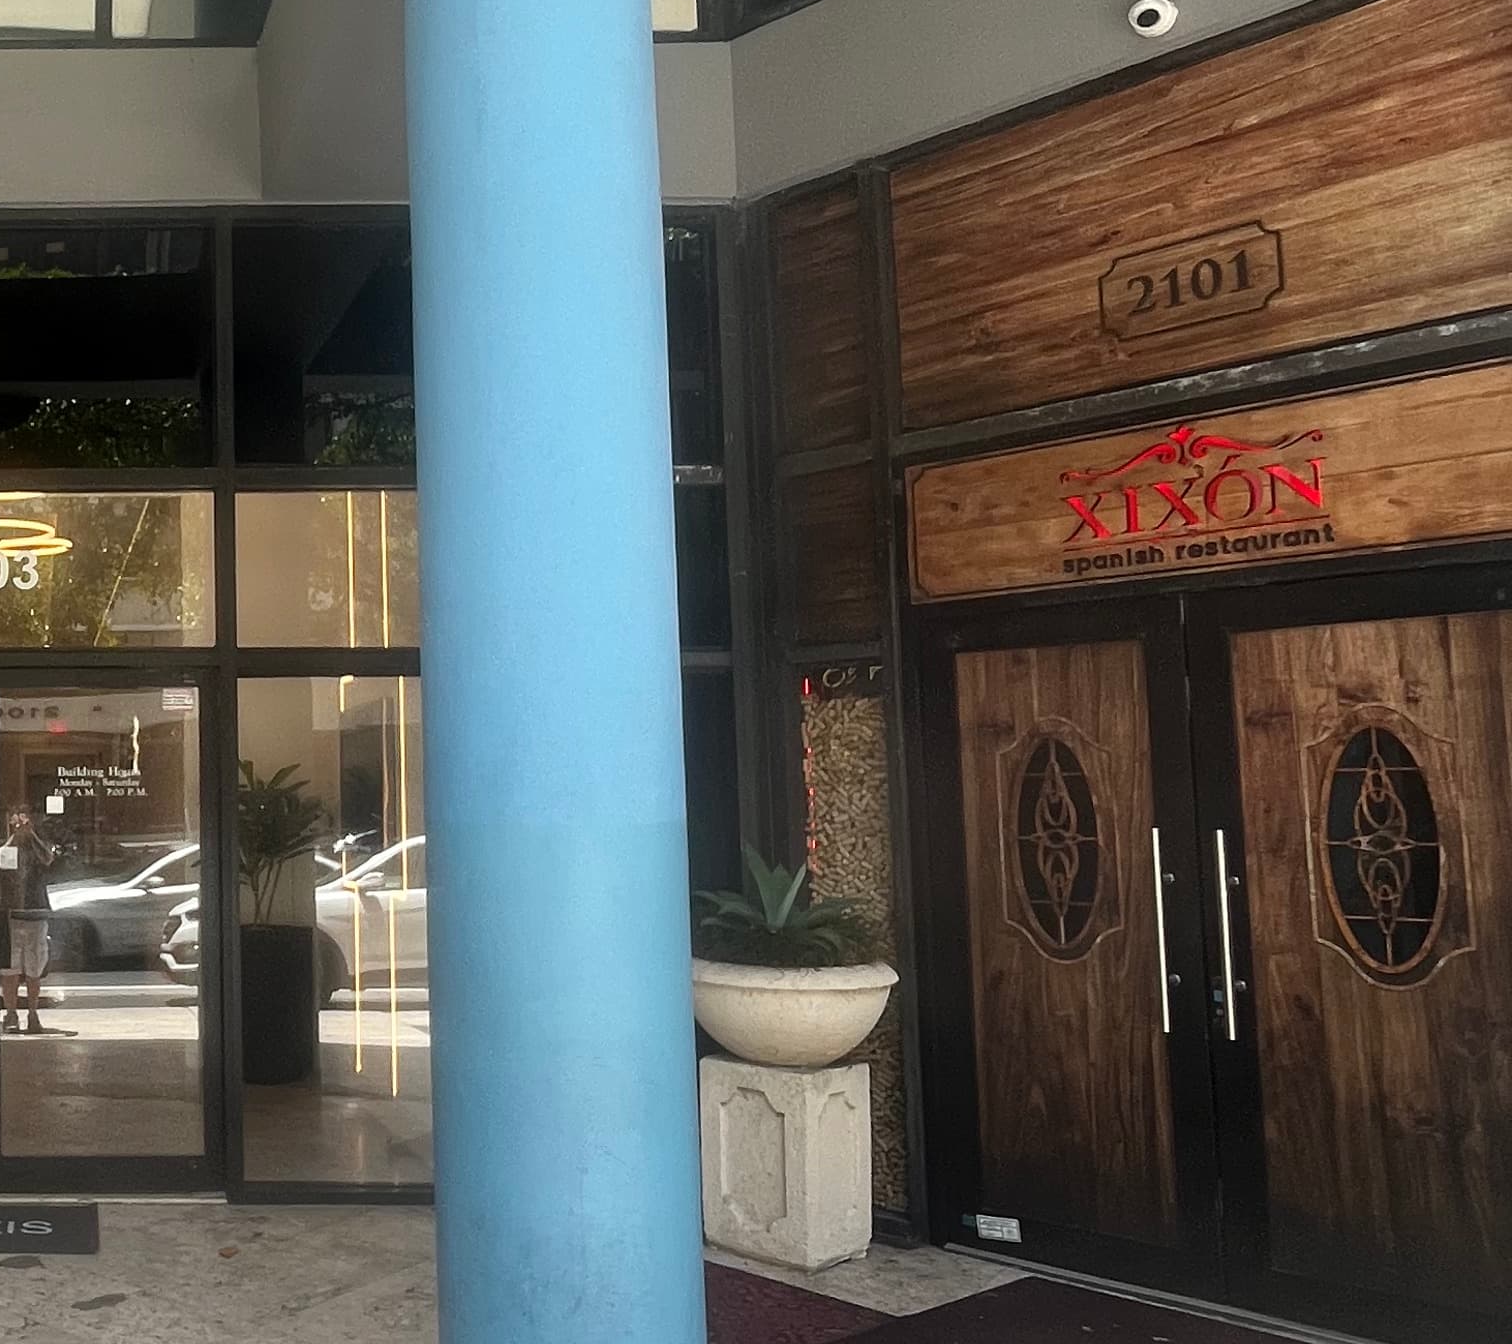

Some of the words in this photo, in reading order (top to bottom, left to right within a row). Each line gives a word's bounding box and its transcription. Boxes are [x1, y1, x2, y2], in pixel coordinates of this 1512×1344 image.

[1126, 249, 1258, 316] 2101
[1060, 454, 1327, 544] XIXÓN
[1063, 545, 1164, 575] spanish
[1175, 523, 1335, 561] restaurant
[57, 766, 104, 778] Building
